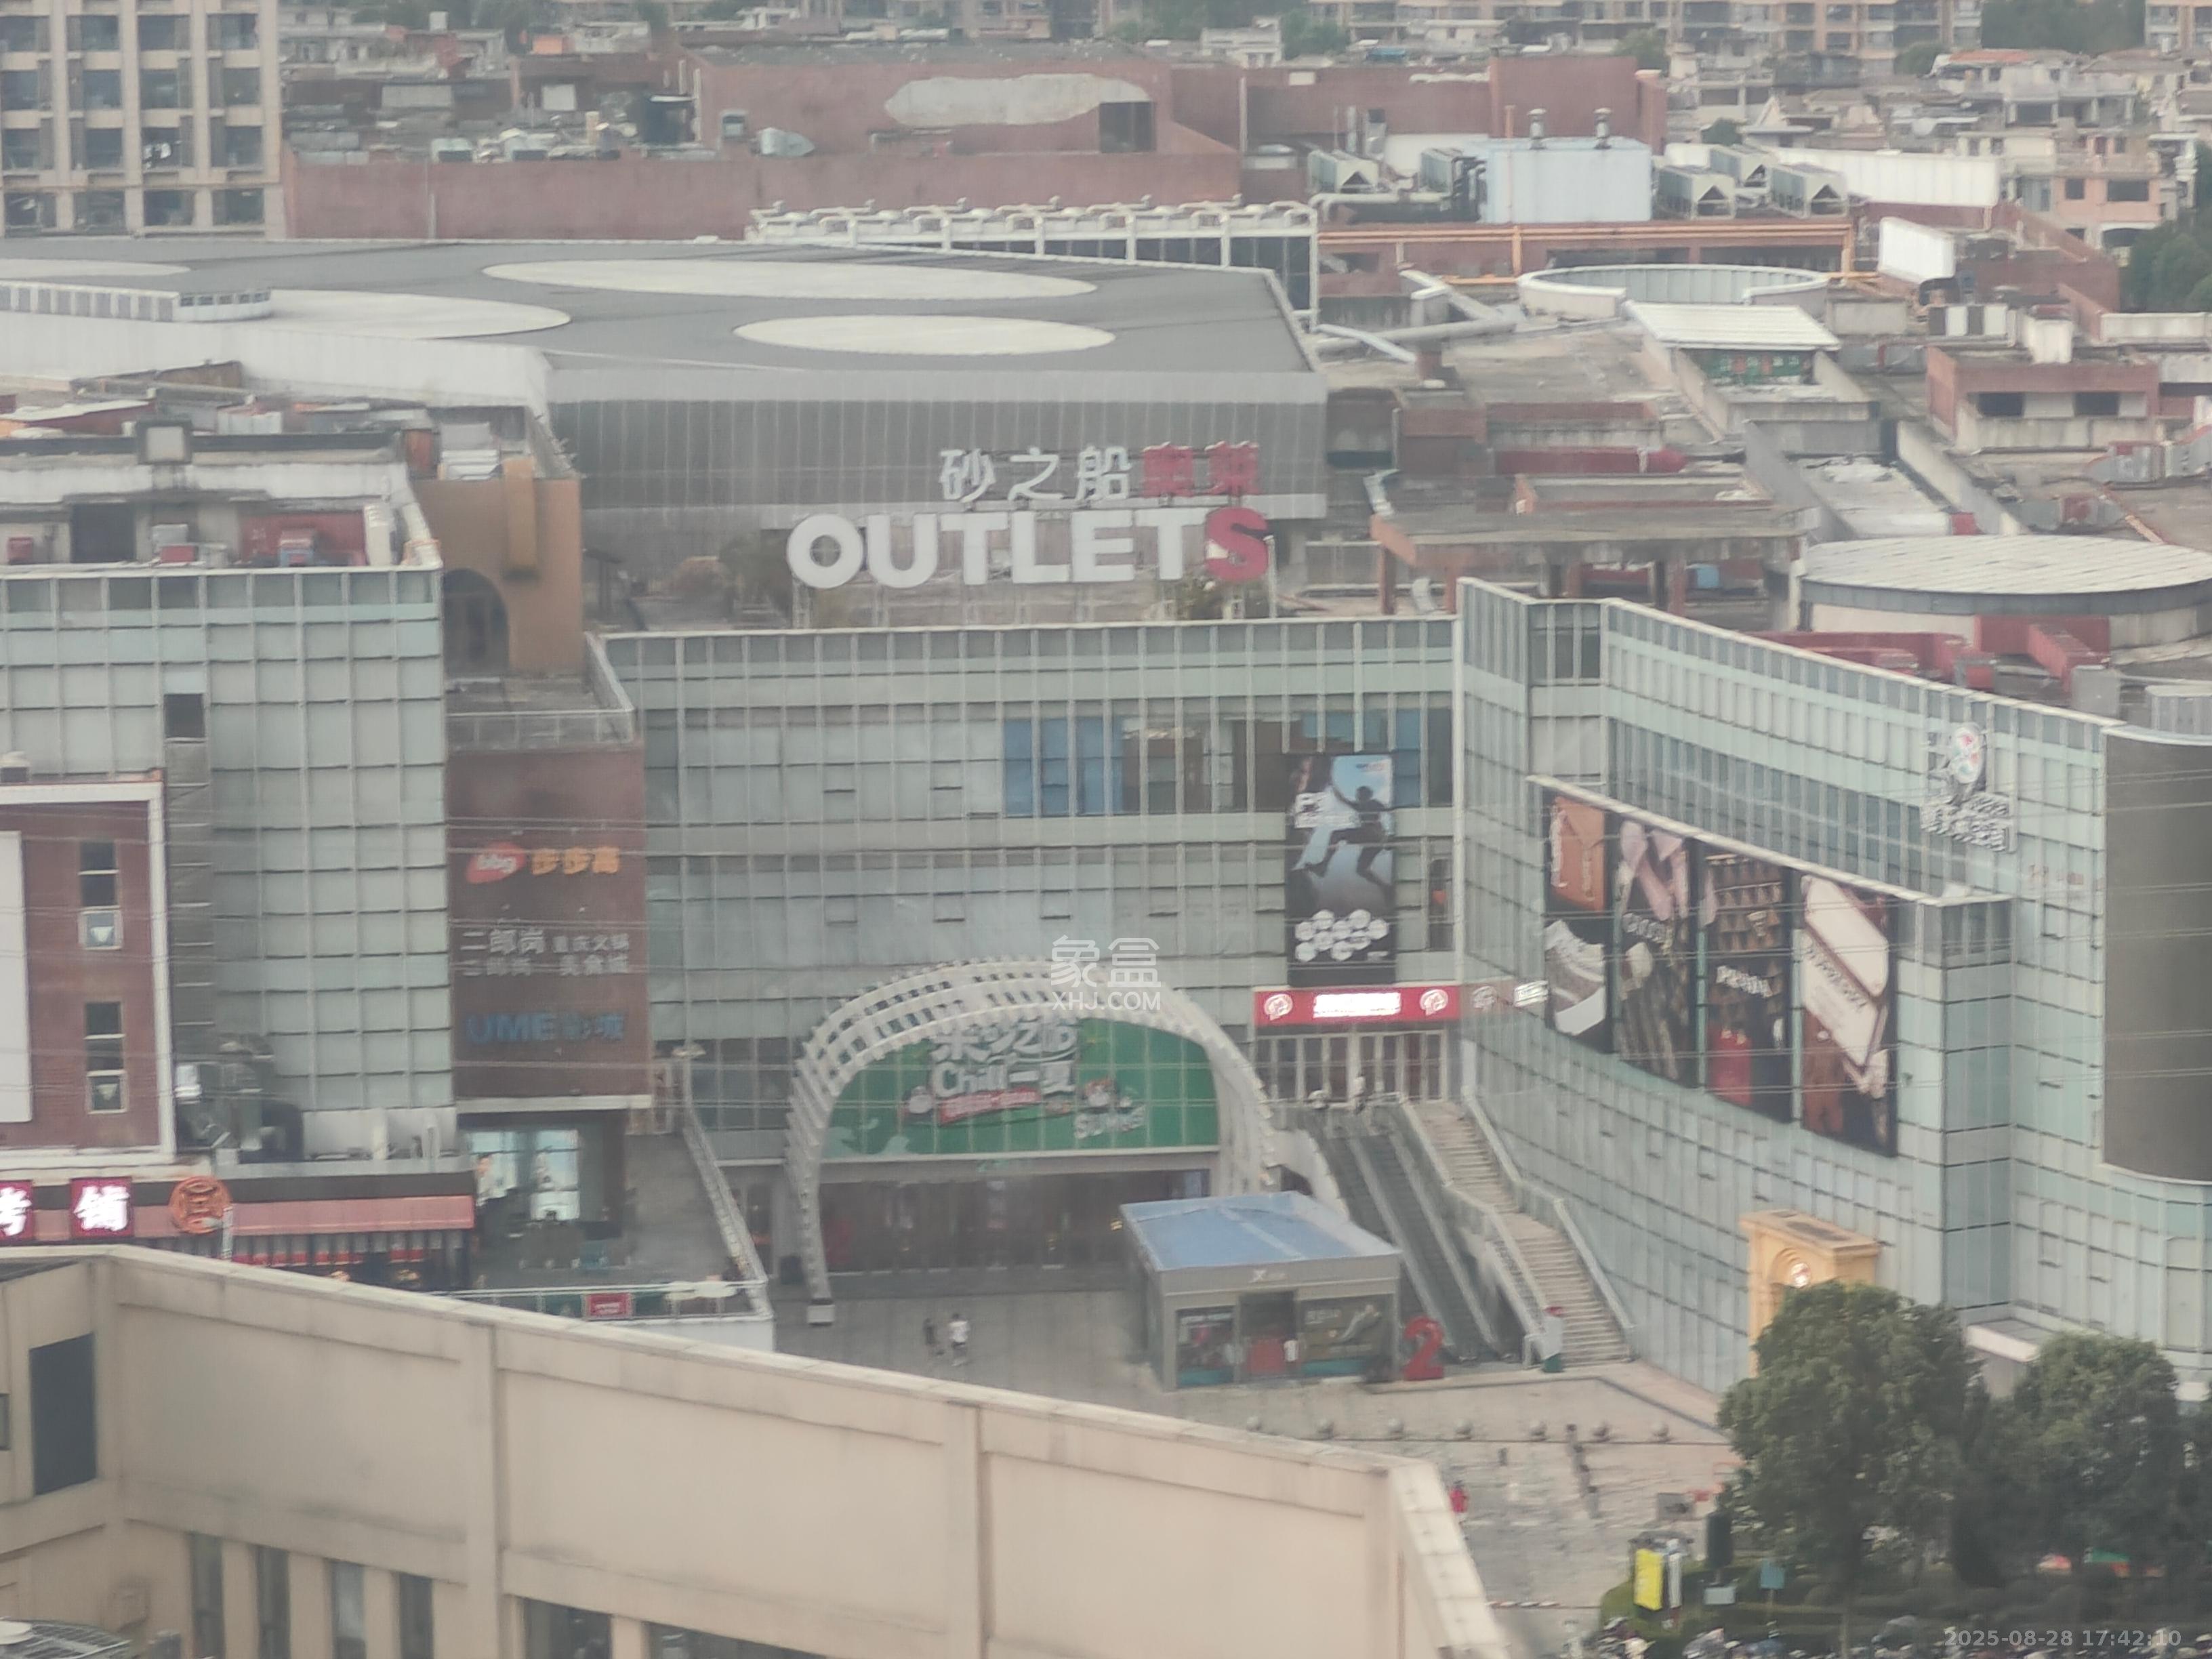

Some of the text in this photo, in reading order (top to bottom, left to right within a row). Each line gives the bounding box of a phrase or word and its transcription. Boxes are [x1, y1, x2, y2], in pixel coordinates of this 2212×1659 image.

[787, 508, 1269, 588] OUTLETS
[466, 1011, 556, 1043] UME
[1404, 1315, 1445, 1381] 2
